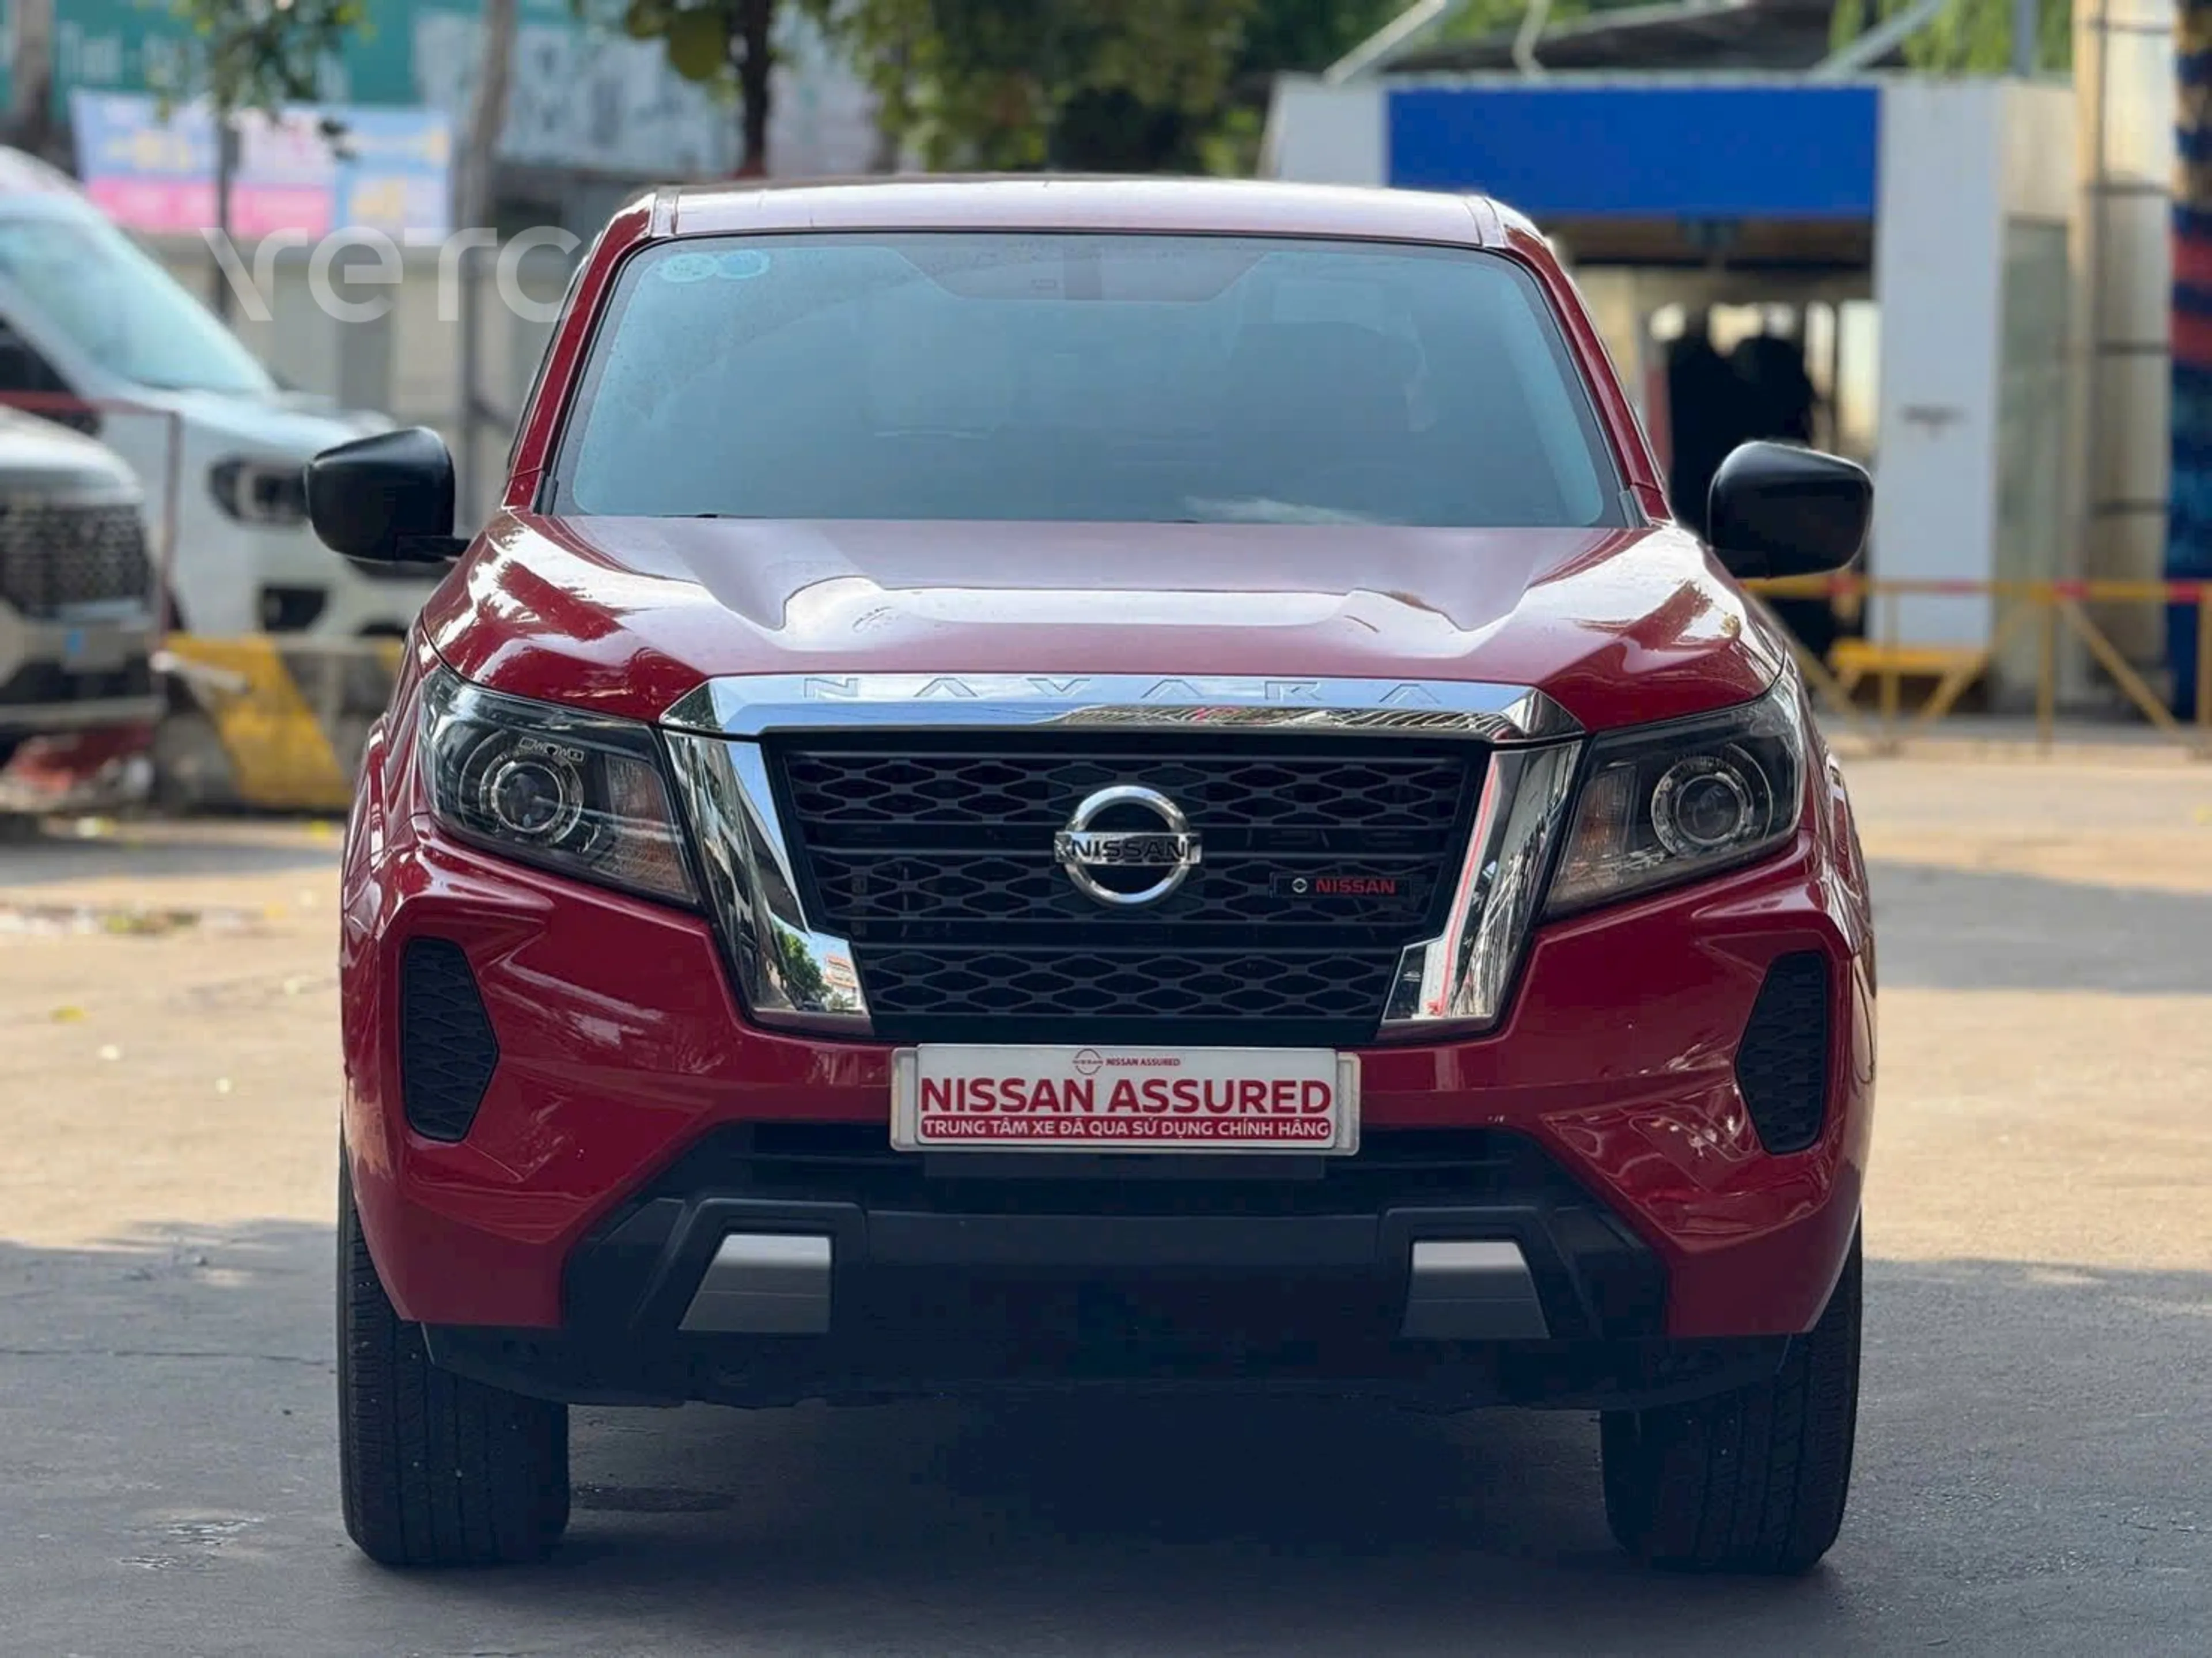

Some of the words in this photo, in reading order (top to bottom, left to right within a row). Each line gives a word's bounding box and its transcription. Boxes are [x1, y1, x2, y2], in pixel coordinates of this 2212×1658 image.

[804, 677, 1443, 705] NAVARA
[1071, 839, 1186, 861] NISSAN
[1316, 878, 1395, 894] NISSAN
[1105, 1057, 1139, 1067] NISSAN
[1140, 1058, 1181, 1067] ASSURED
[921, 1077, 1094, 1112] NISSAN
[1107, 1079, 1332, 1114] ASSURED
[924, 1120, 986, 1135] TRUNG
[990, 1117, 1028, 1135] TÂM
[1032, 1120, 1055, 1135] XE
[1059, 1117, 1086, 1135] ĐÃ
[1089, 1121, 1128, 1136] QUA
[1161, 1121, 1213, 1138] DỤNG
[1218, 1117, 1275, 1136] CHÍNH
